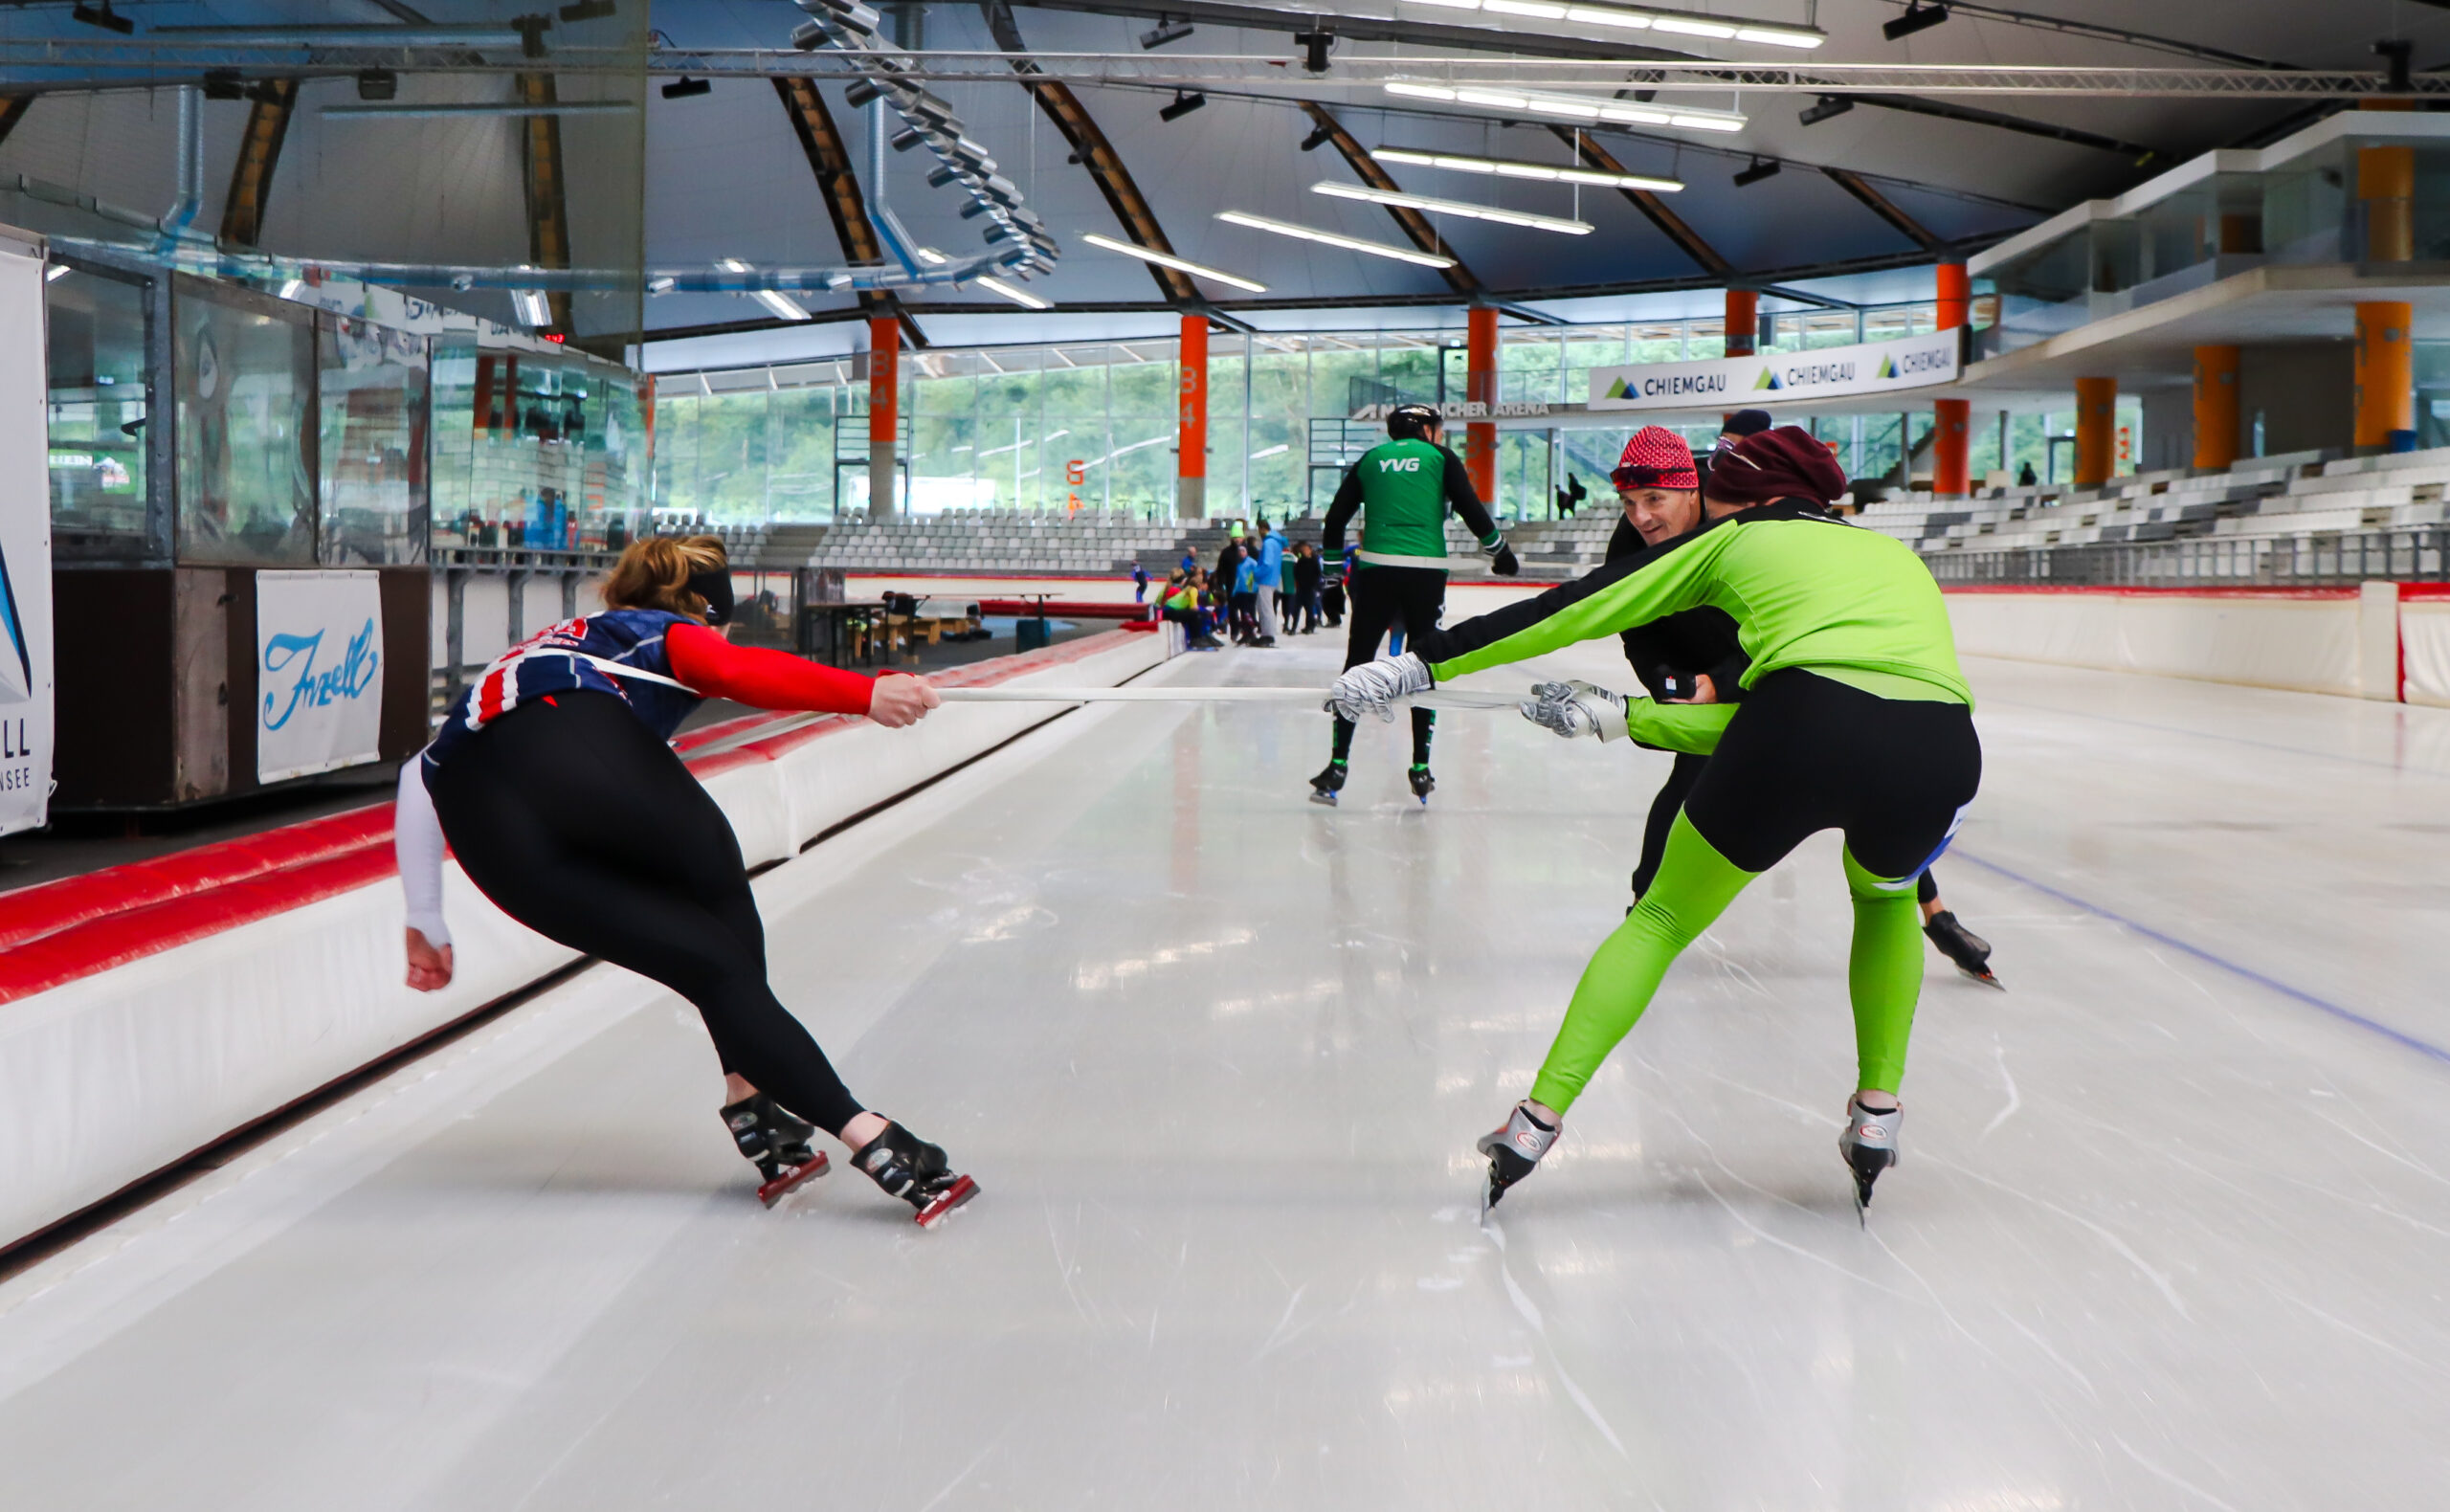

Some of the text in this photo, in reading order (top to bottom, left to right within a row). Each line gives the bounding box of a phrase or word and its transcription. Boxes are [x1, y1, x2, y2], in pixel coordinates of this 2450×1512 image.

[1904, 346, 1952, 374] CHIEMGAU
[1644, 373, 1726, 396] CHIEMGAU
[1787, 361, 1856, 387] CHIEMGAU
[1493, 402, 1550, 417] ARENA
[1379, 456, 1420, 473] YVG
